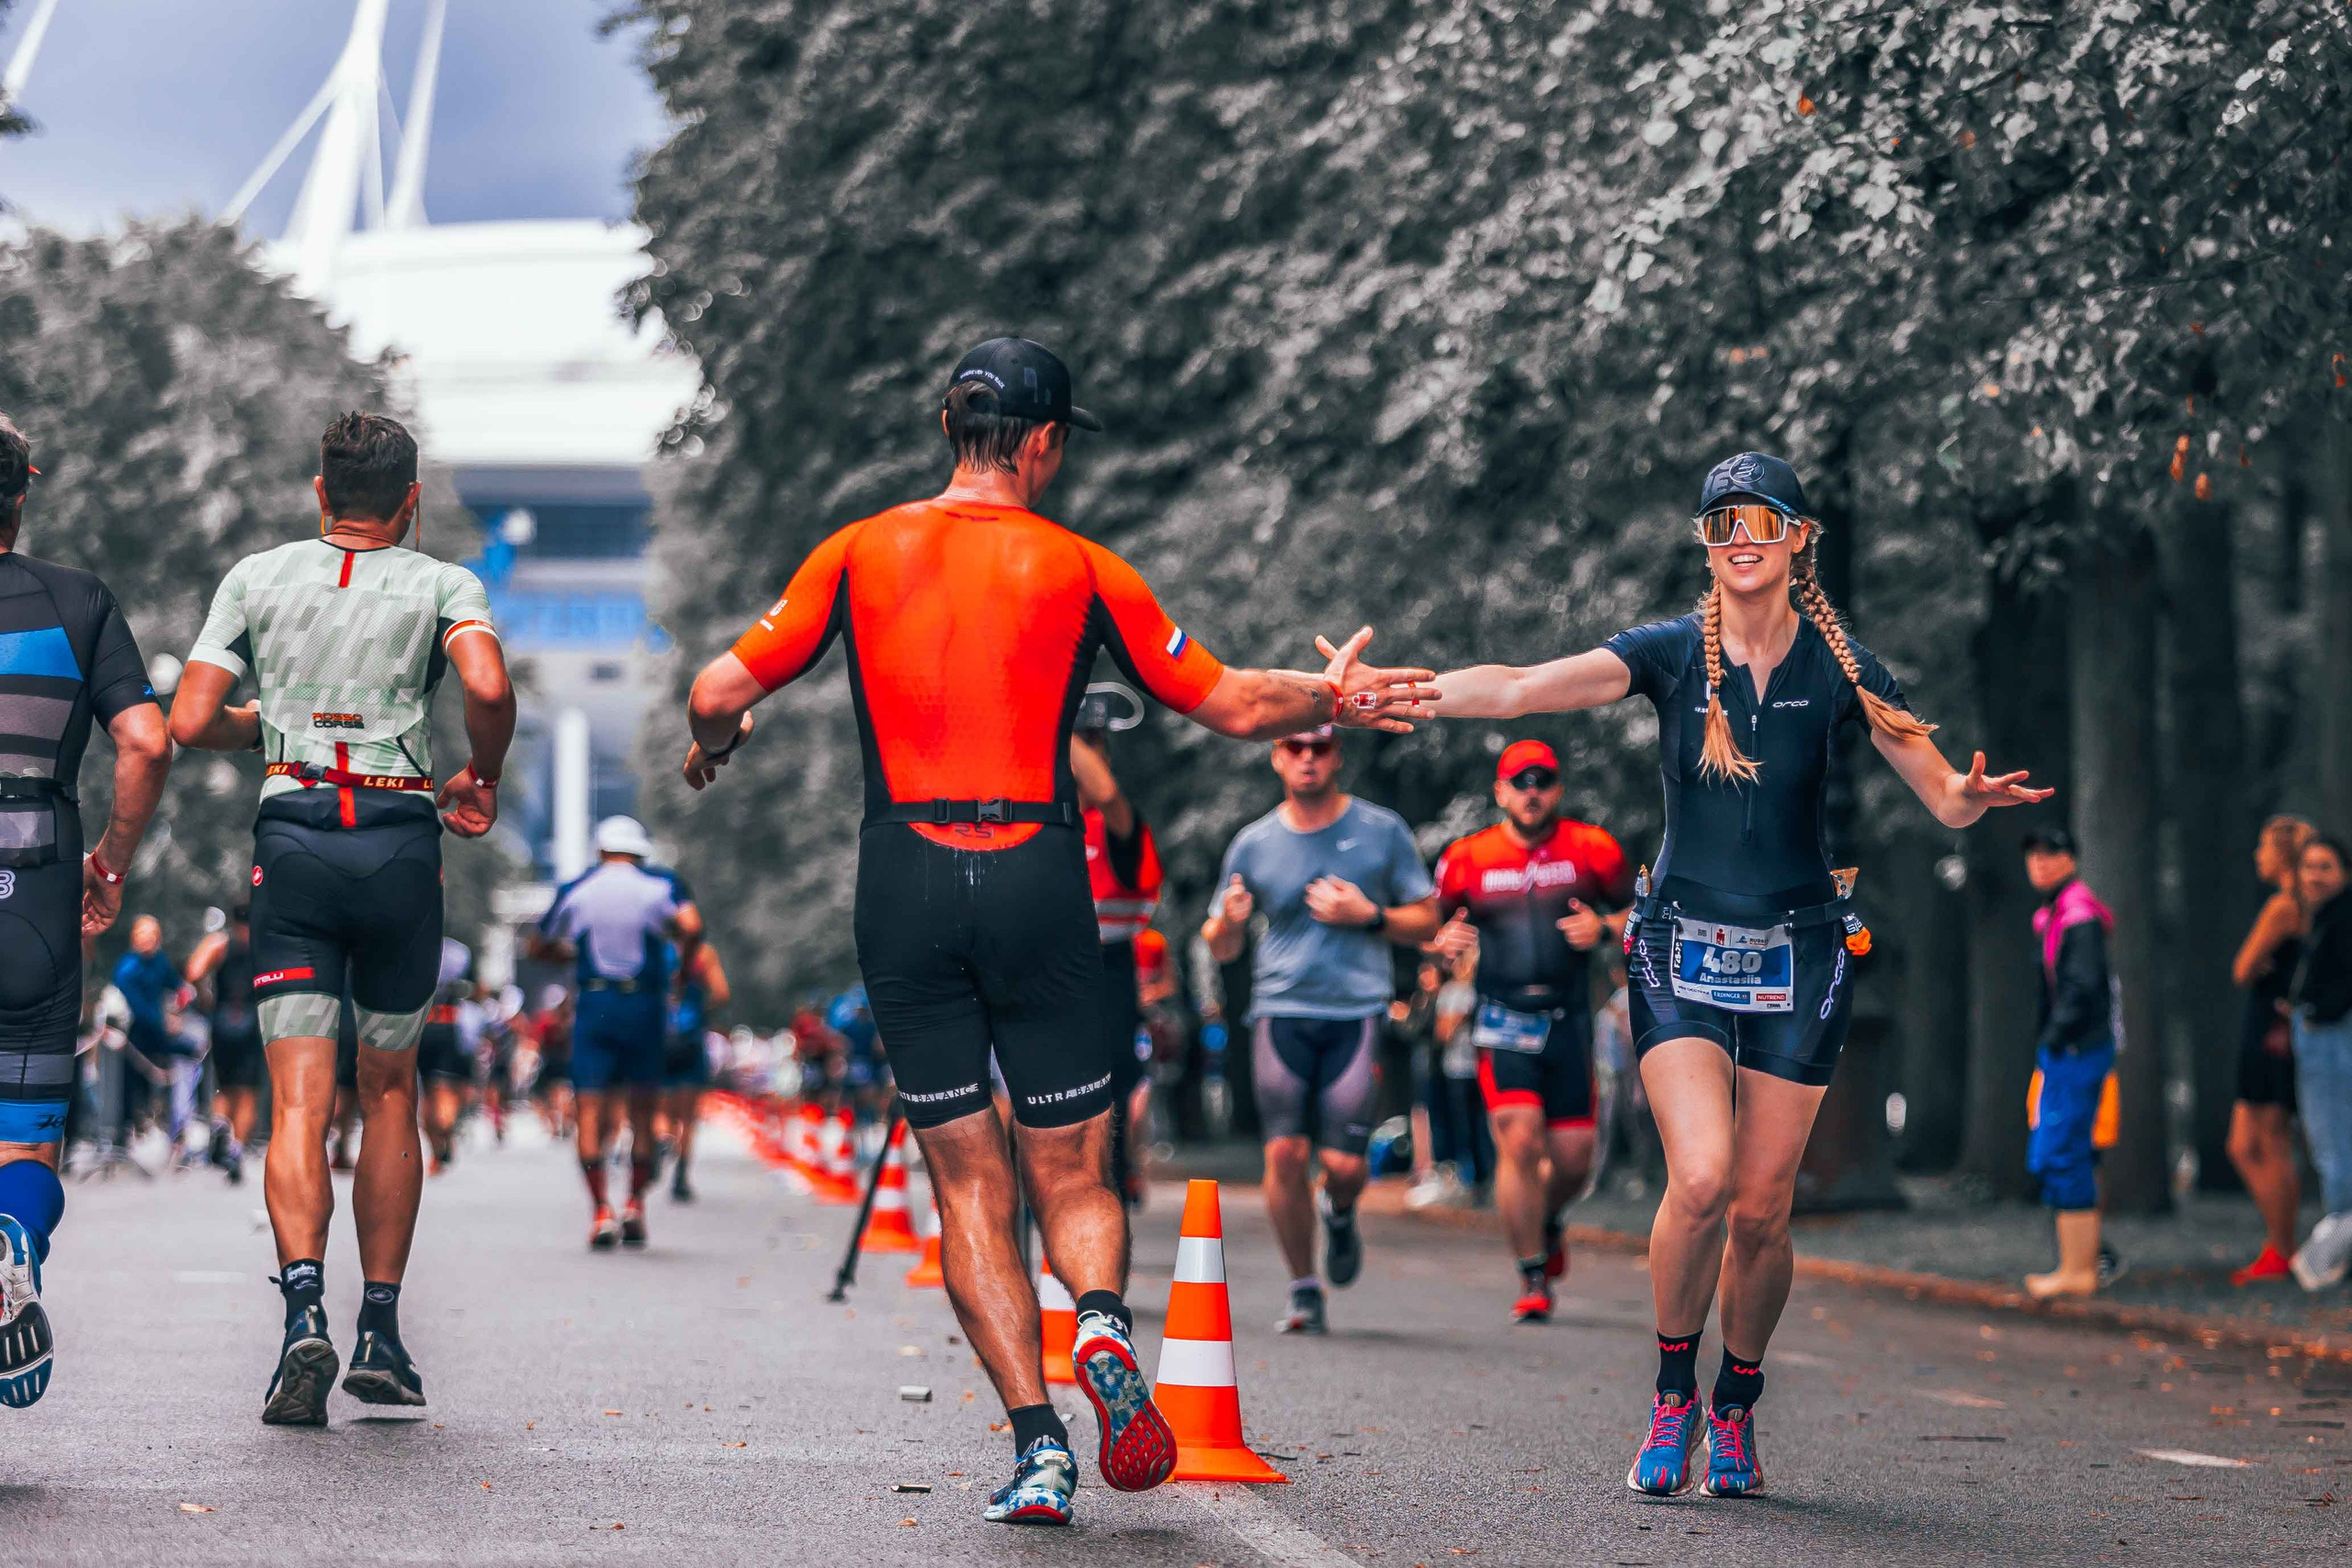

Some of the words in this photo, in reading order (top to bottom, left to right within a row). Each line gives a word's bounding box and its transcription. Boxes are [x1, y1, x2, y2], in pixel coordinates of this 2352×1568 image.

[1772, 700, 1810, 708] orca
[311, 713, 364, 722] ROSSO
[363, 776, 405, 788] LEKI
[1702, 945, 1762, 975] 480
[1699, 972, 1762, 985] Anastasiia
[1713, 991, 1742, 1000] ERDINGER
